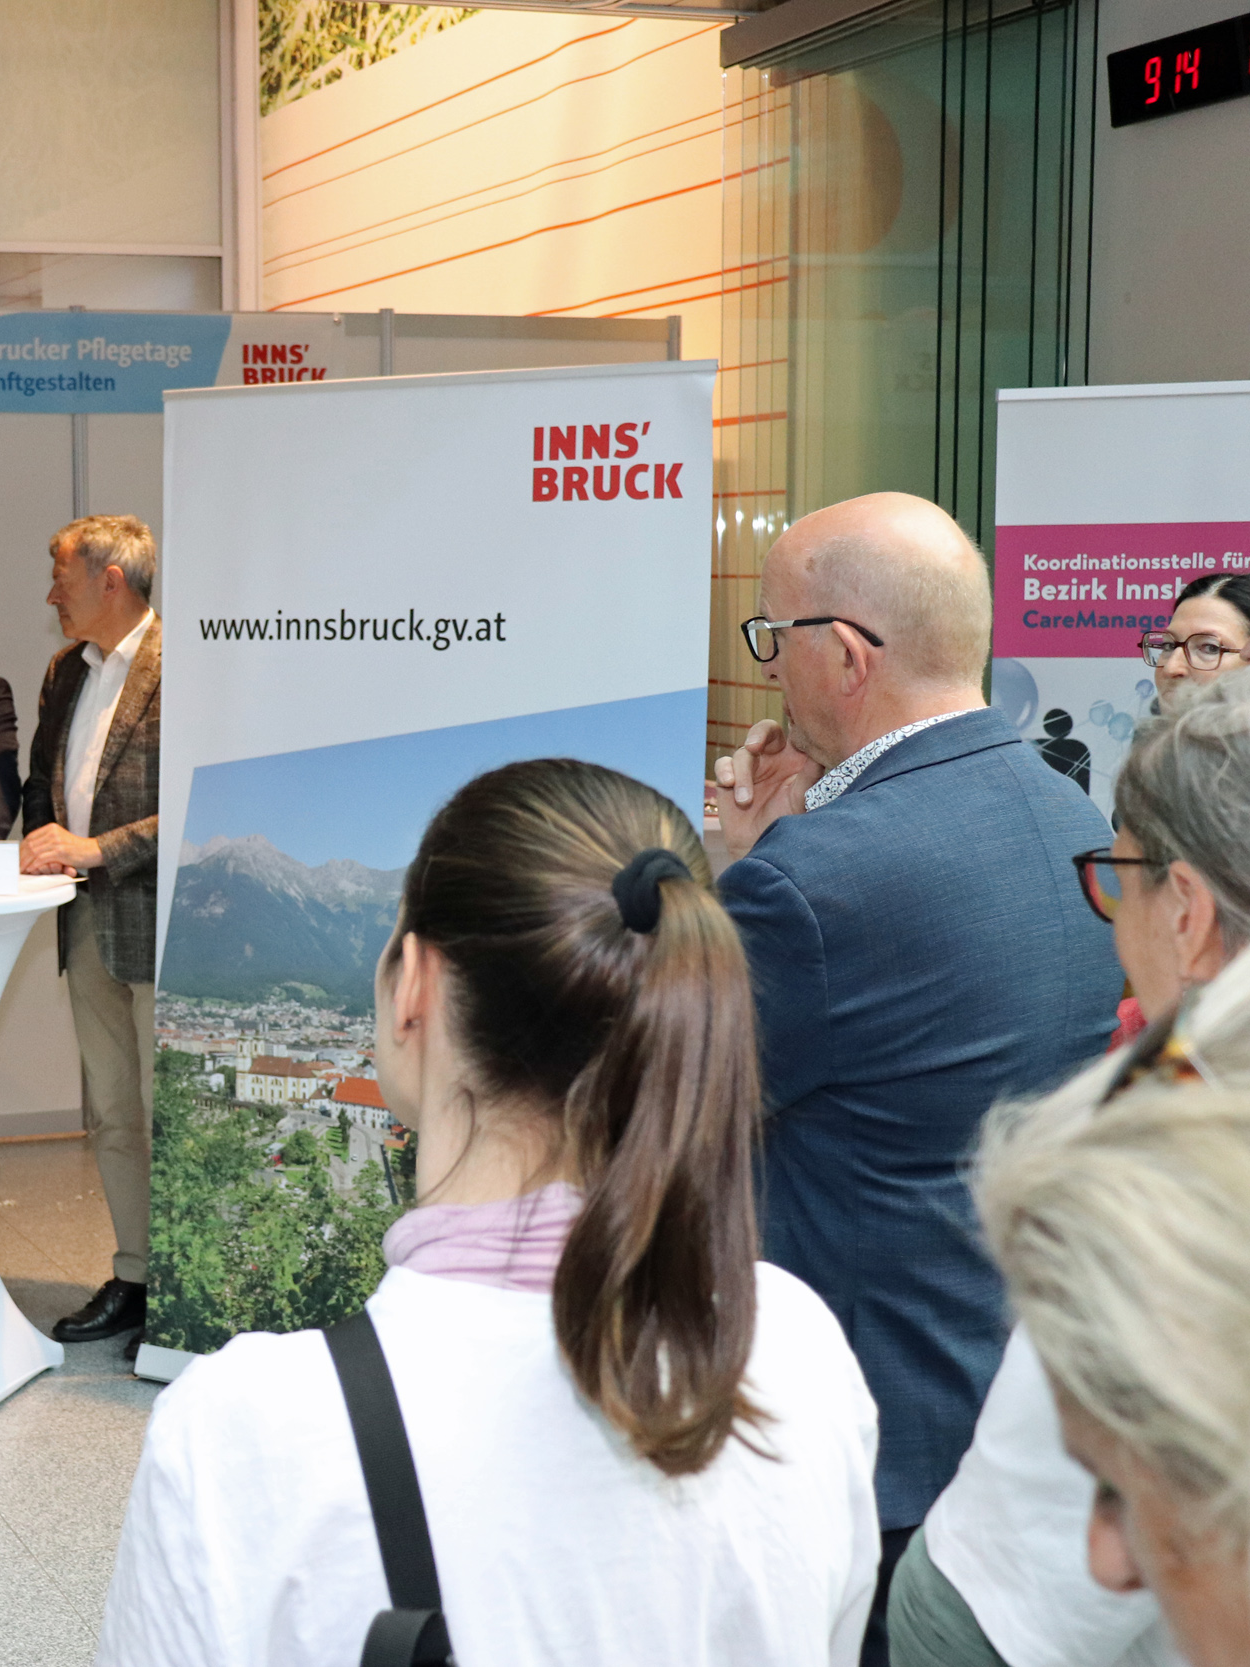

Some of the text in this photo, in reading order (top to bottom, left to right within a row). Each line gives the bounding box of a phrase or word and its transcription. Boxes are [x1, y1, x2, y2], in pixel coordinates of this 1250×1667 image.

[76, 337, 193, 368] Pflegetage
[242, 344, 309, 365] INNS'
[243, 367, 327, 385] BRUCK
[532, 421, 651, 462] INNS'
[531, 463, 684, 502] BRUCK
[1023, 551, 1250, 571] Koordinationsstelle für
[1023, 577, 1108, 600] Bezirk
[199, 608, 508, 652] www.innsbruck.gv.at
[1022, 609, 1173, 633] CareManage
